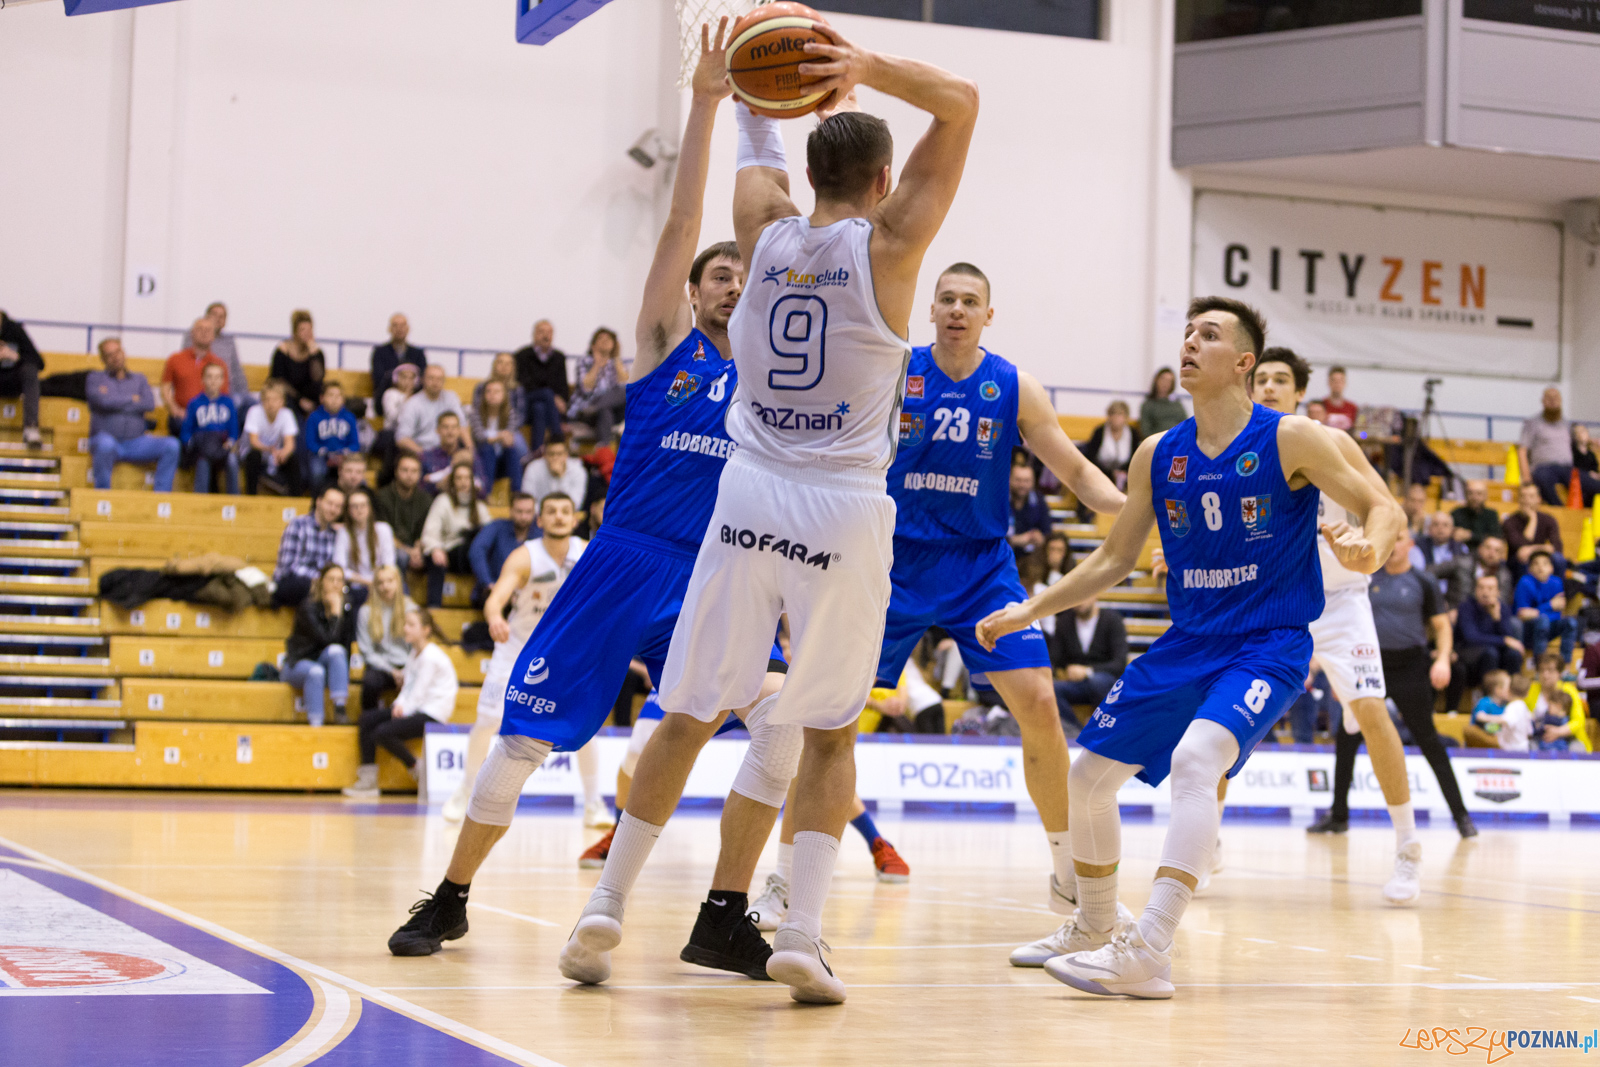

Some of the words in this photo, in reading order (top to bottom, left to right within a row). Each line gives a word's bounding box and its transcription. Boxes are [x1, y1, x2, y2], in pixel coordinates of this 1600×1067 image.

[1223, 243, 1486, 310] CITYZEN
[768, 294, 828, 390] 9
[932, 407, 970, 443] 23
[659, 431, 737, 460] OŁOBRZEG
[904, 472, 979, 497] KOŁOBRZEG
[1201, 491, 1223, 531] 8
[1183, 564, 1259, 589] KOŁOBRZEG
[506, 685, 557, 714] Energa
[1244, 678, 1272, 714] 8
